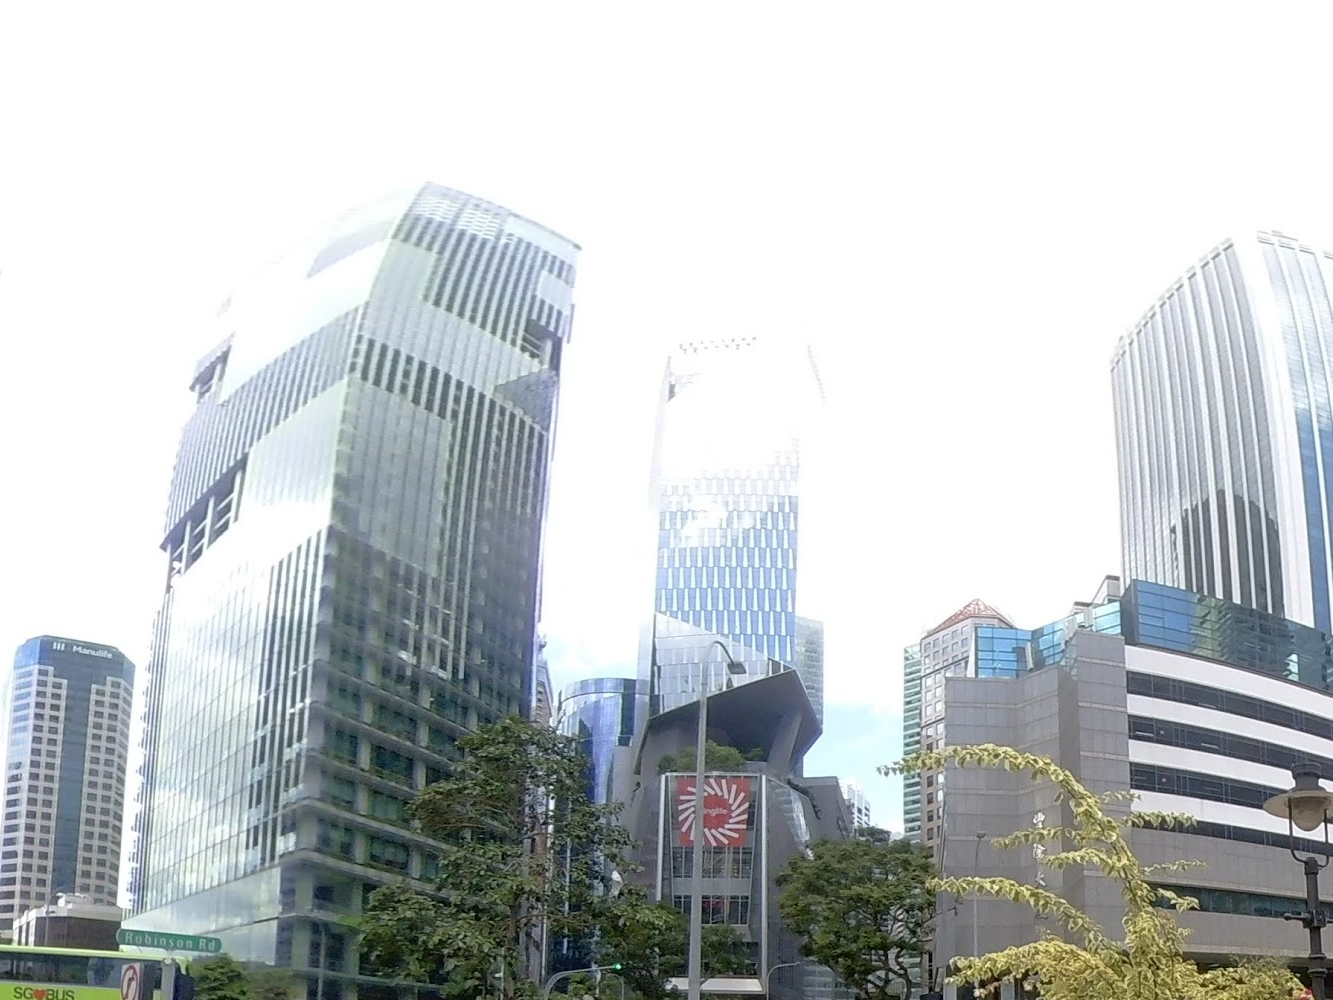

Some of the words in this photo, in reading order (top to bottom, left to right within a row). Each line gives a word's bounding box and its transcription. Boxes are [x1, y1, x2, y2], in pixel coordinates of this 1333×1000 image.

[73, 645, 113, 659] Manulife
[124, 931, 193, 949] Robinson
[198, 938, 215, 951] Rd
